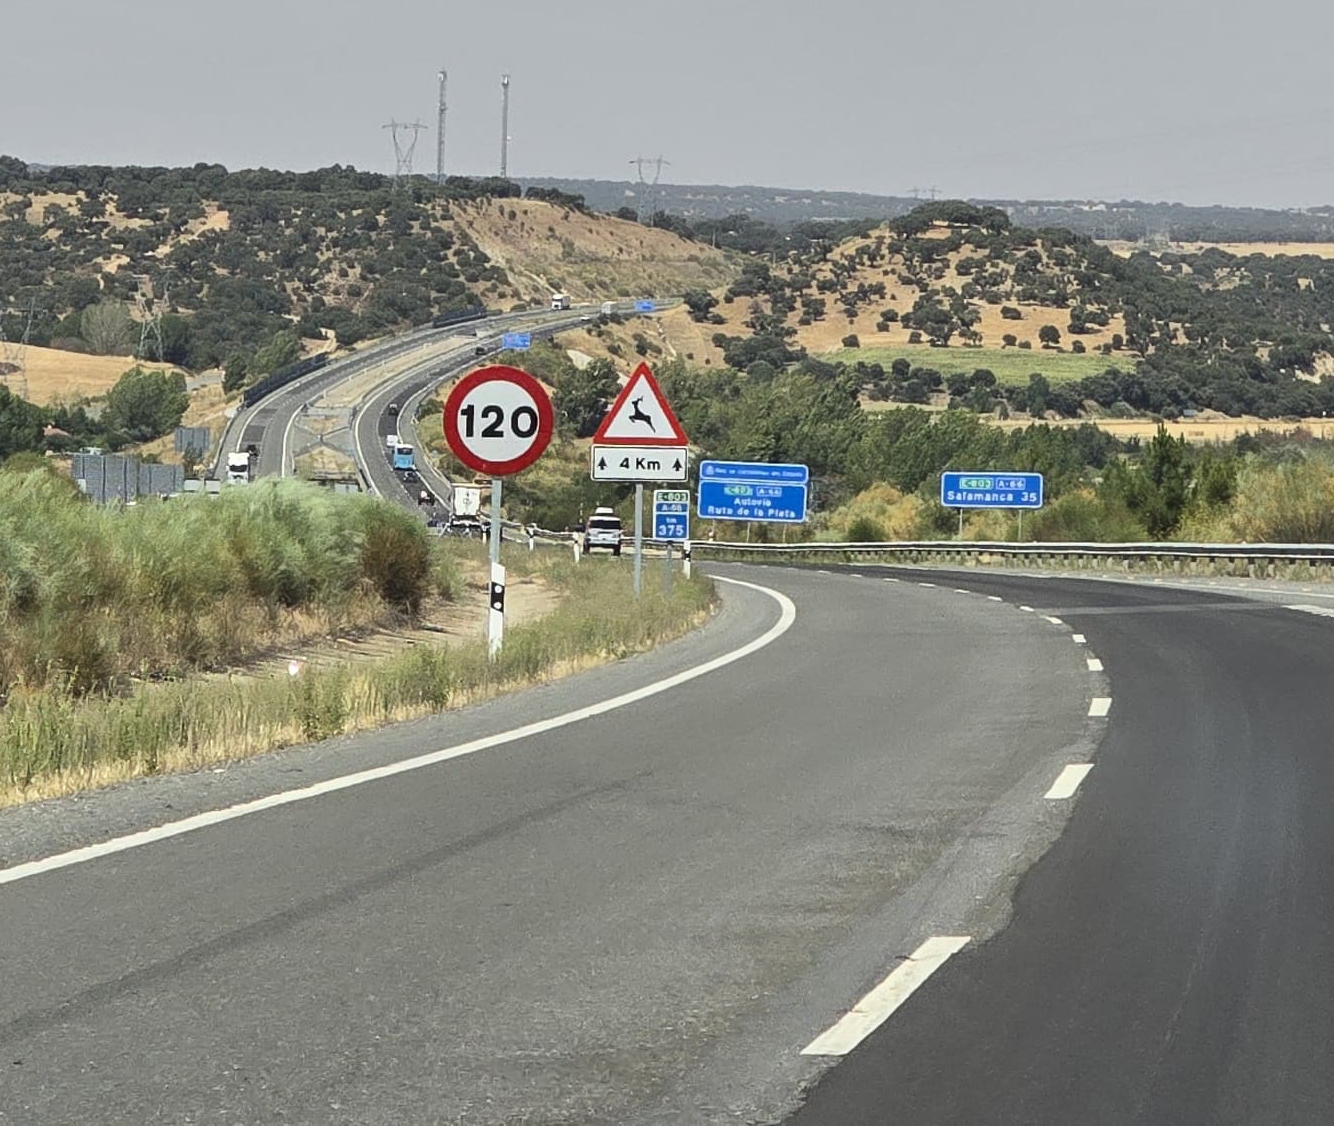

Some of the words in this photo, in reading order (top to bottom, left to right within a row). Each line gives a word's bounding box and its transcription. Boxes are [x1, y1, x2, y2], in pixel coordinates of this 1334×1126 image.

[460, 404, 538, 438] 120
[619, 457, 630, 469] 4
[635, 457, 661, 471] Km
[947, 491, 1014, 502] Salamanca
[1021, 492, 1037, 502] 35
[707, 506, 734, 515] Ruta
[737, 507, 750, 516] de
[754, 508, 764, 517] la
[768, 509, 796, 518] Plata
[658, 525, 684, 536] 375
